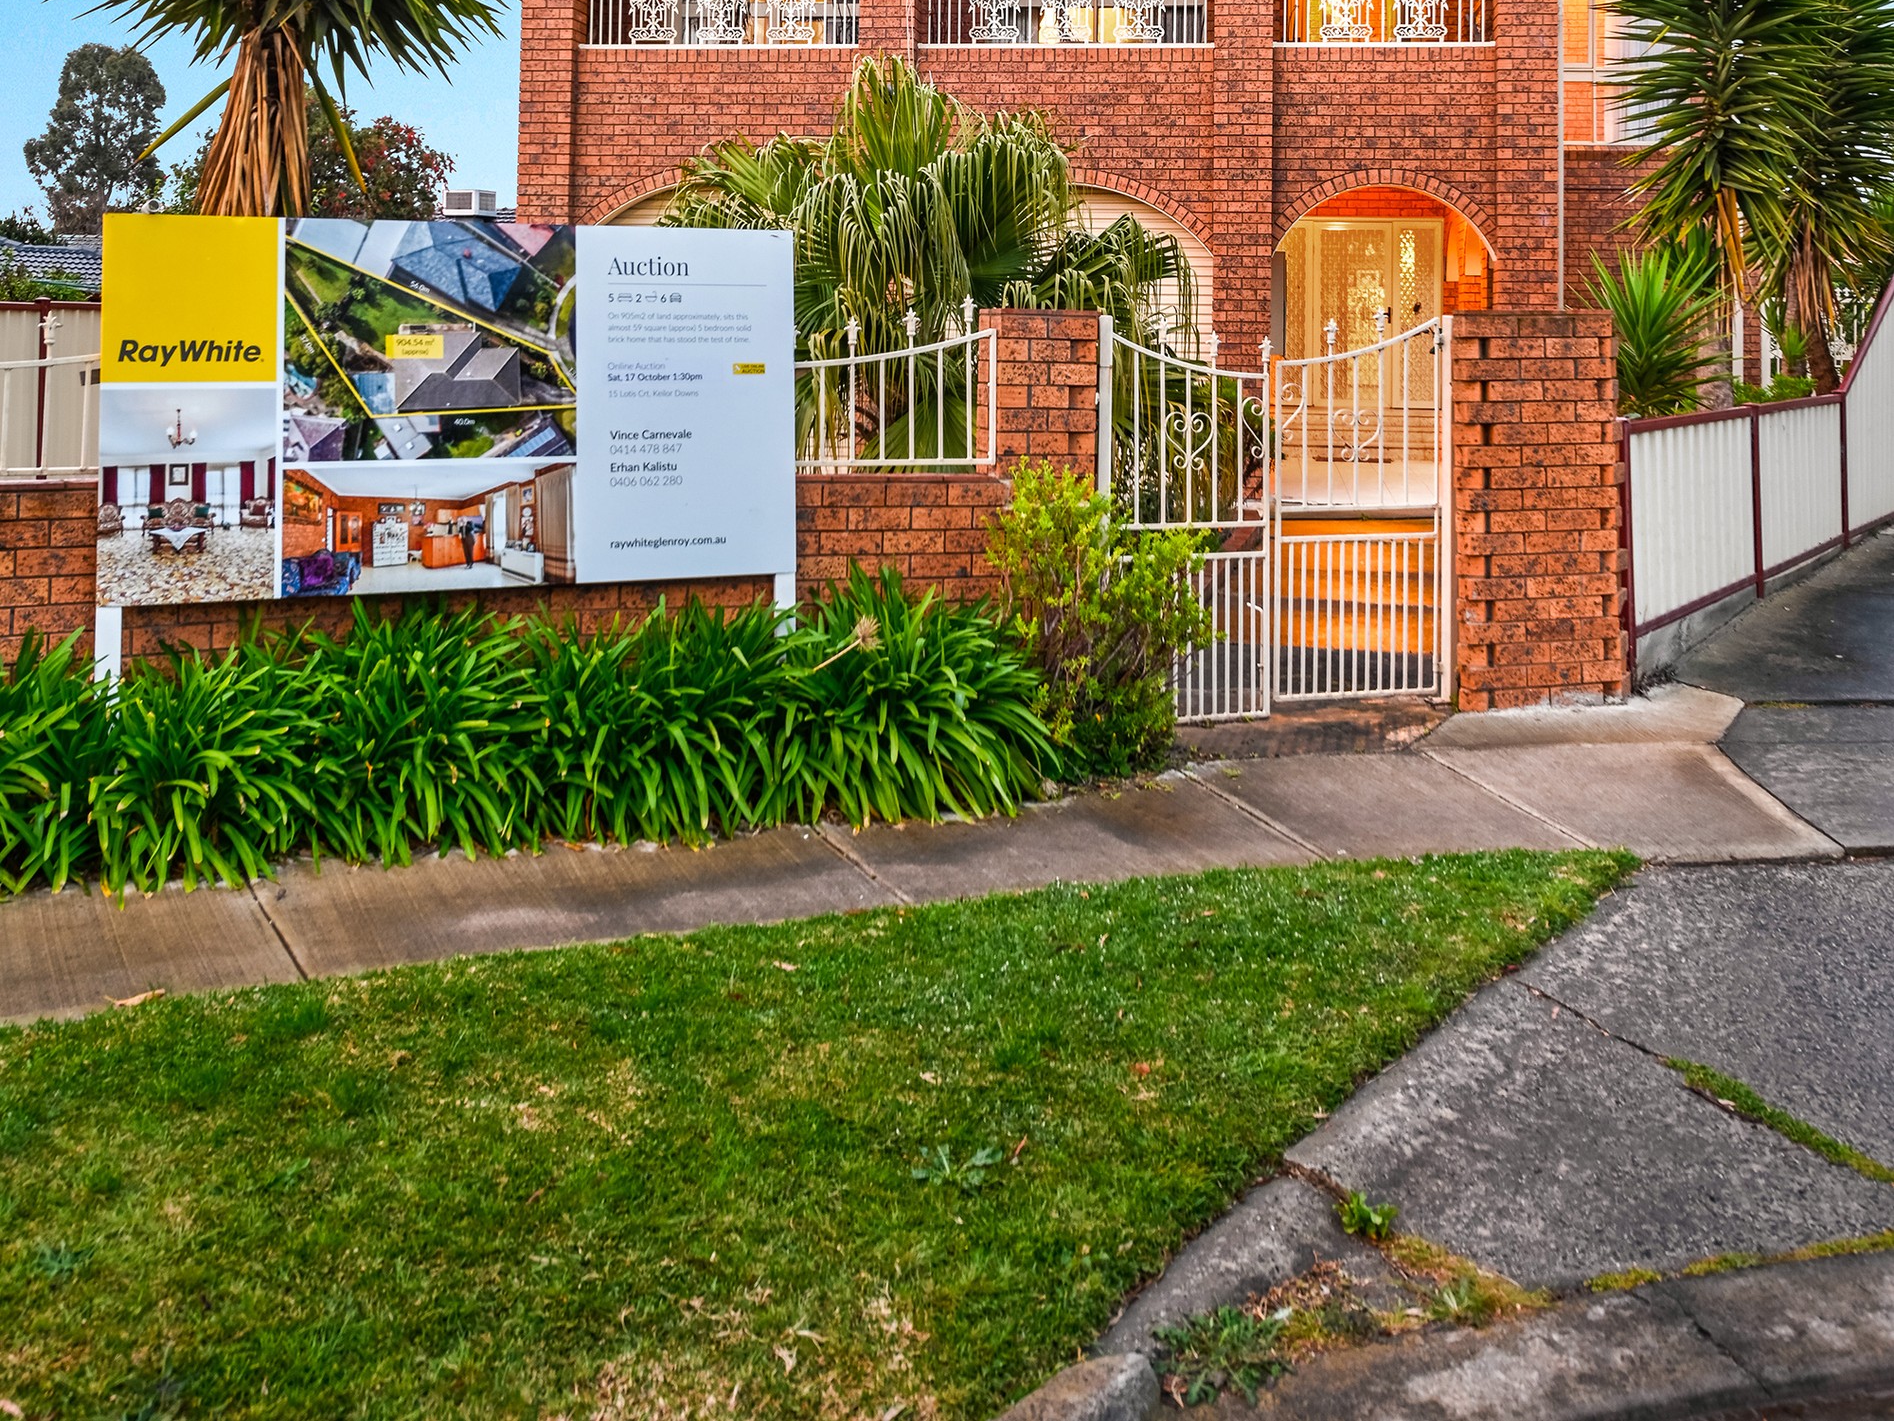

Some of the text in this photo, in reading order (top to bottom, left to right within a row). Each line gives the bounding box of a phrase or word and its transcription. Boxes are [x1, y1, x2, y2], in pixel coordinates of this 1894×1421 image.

[607, 256, 689, 277] Auction
[608, 293, 667, 303] 5 2 6
[607, 311, 619, 320] On
[647, 312, 656, 321] of
[657, 312, 671, 321] land
[672, 312, 723, 323] approximately,
[723, 313, 735, 321] sits
[736, 312, 748, 321] this
[607, 324, 631, 332] almost
[643, 325, 667, 333] square
[668, 324, 697, 333] (approx)
[703, 324, 735, 332] bedroom
[735, 324, 752, 332] solid
[607, 335, 750, 343] brick home that has stood the test of time.
[117, 339, 261, 367] RayWhite
[607, 361, 666, 371] Online Auction
[625, 373, 636, 382] 17
[637, 372, 671, 382] October
[673, 372, 703, 382] 1:30pm
[674, 389, 700, 398] Downs
[609, 429, 693, 440] Vince Carnevale
[609, 443, 682, 455] 0414 478 847
[610, 461, 678, 473] Erhan Kalistu
[609, 475, 683, 487] 0406 062 280
[609, 536, 727, 550] raywhiteglenroy.com.au
